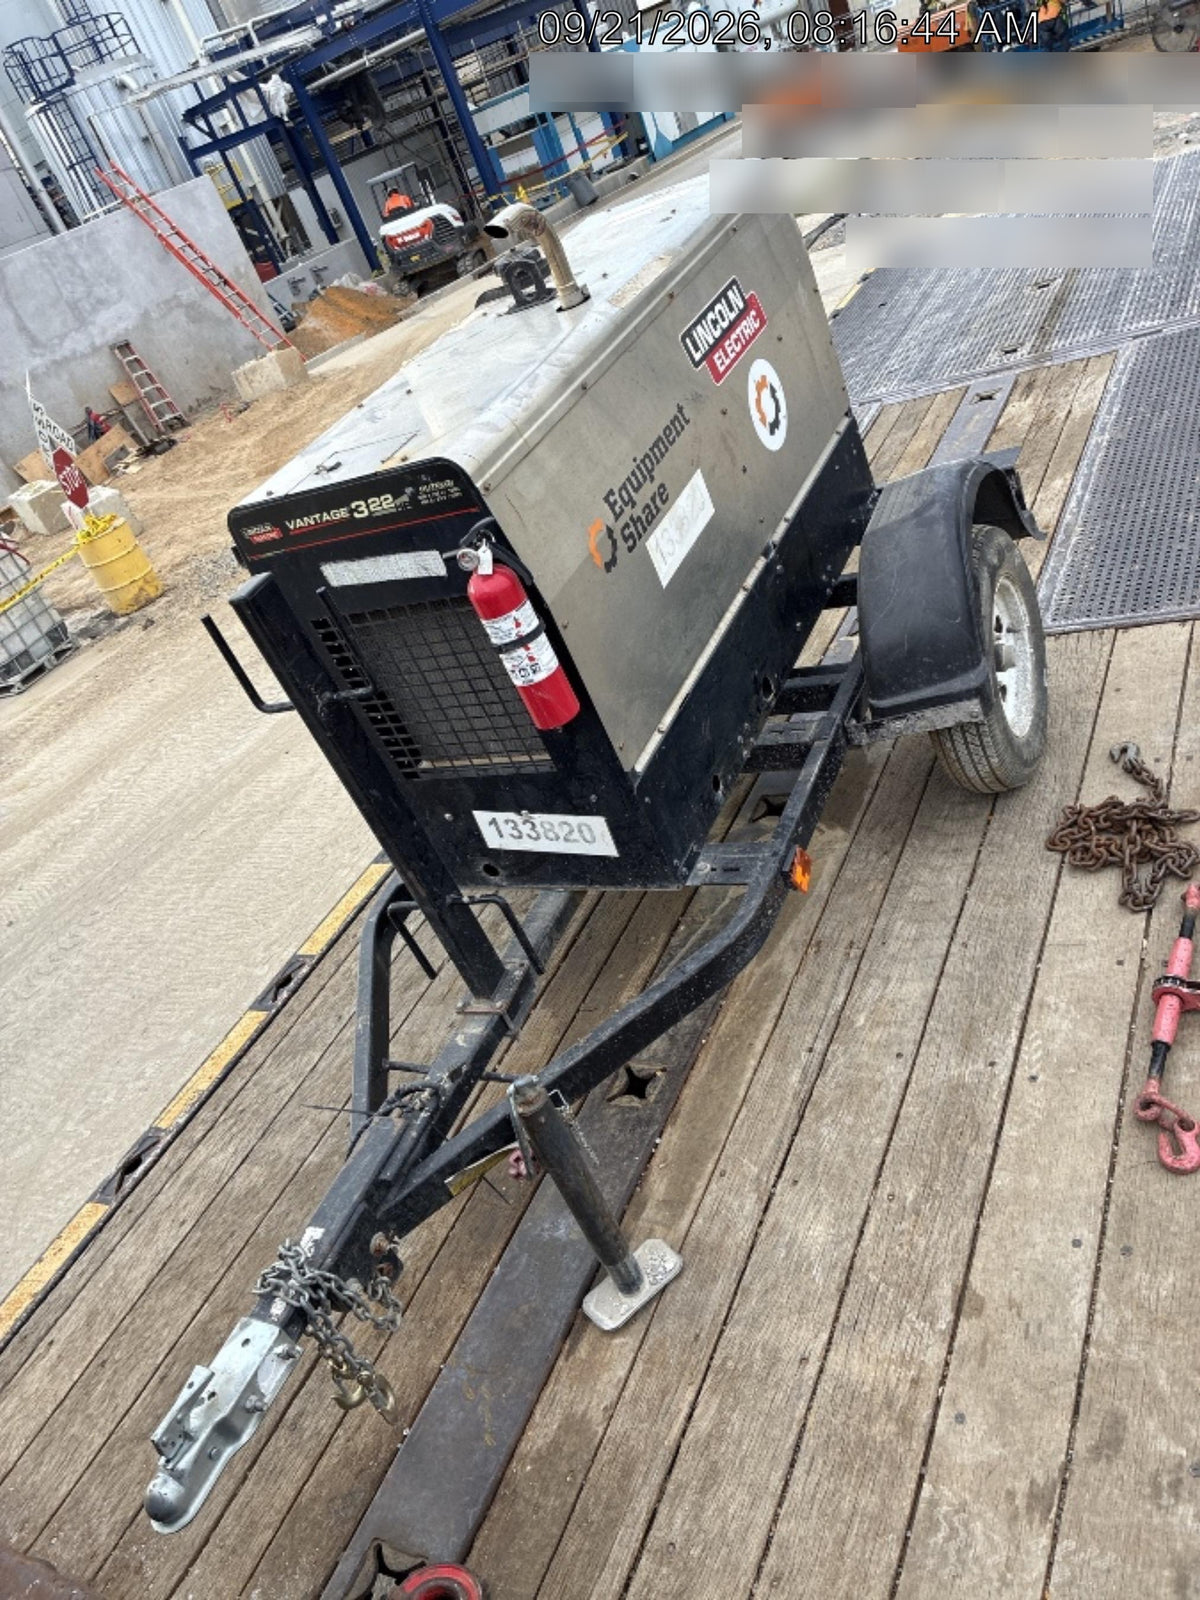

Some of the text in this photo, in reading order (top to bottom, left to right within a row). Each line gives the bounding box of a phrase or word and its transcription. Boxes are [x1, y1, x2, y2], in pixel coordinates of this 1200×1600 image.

[685, 285, 745, 362] LINCOLN
[713, 309, 761, 374] ELECTRIC
[603, 403, 690, 523] Equipment
[285, 508, 350, 530] VANTAGE
[350, 493, 395, 518] 322
[620, 482, 670, 553] Share
[488, 817, 596, 844] 133820
